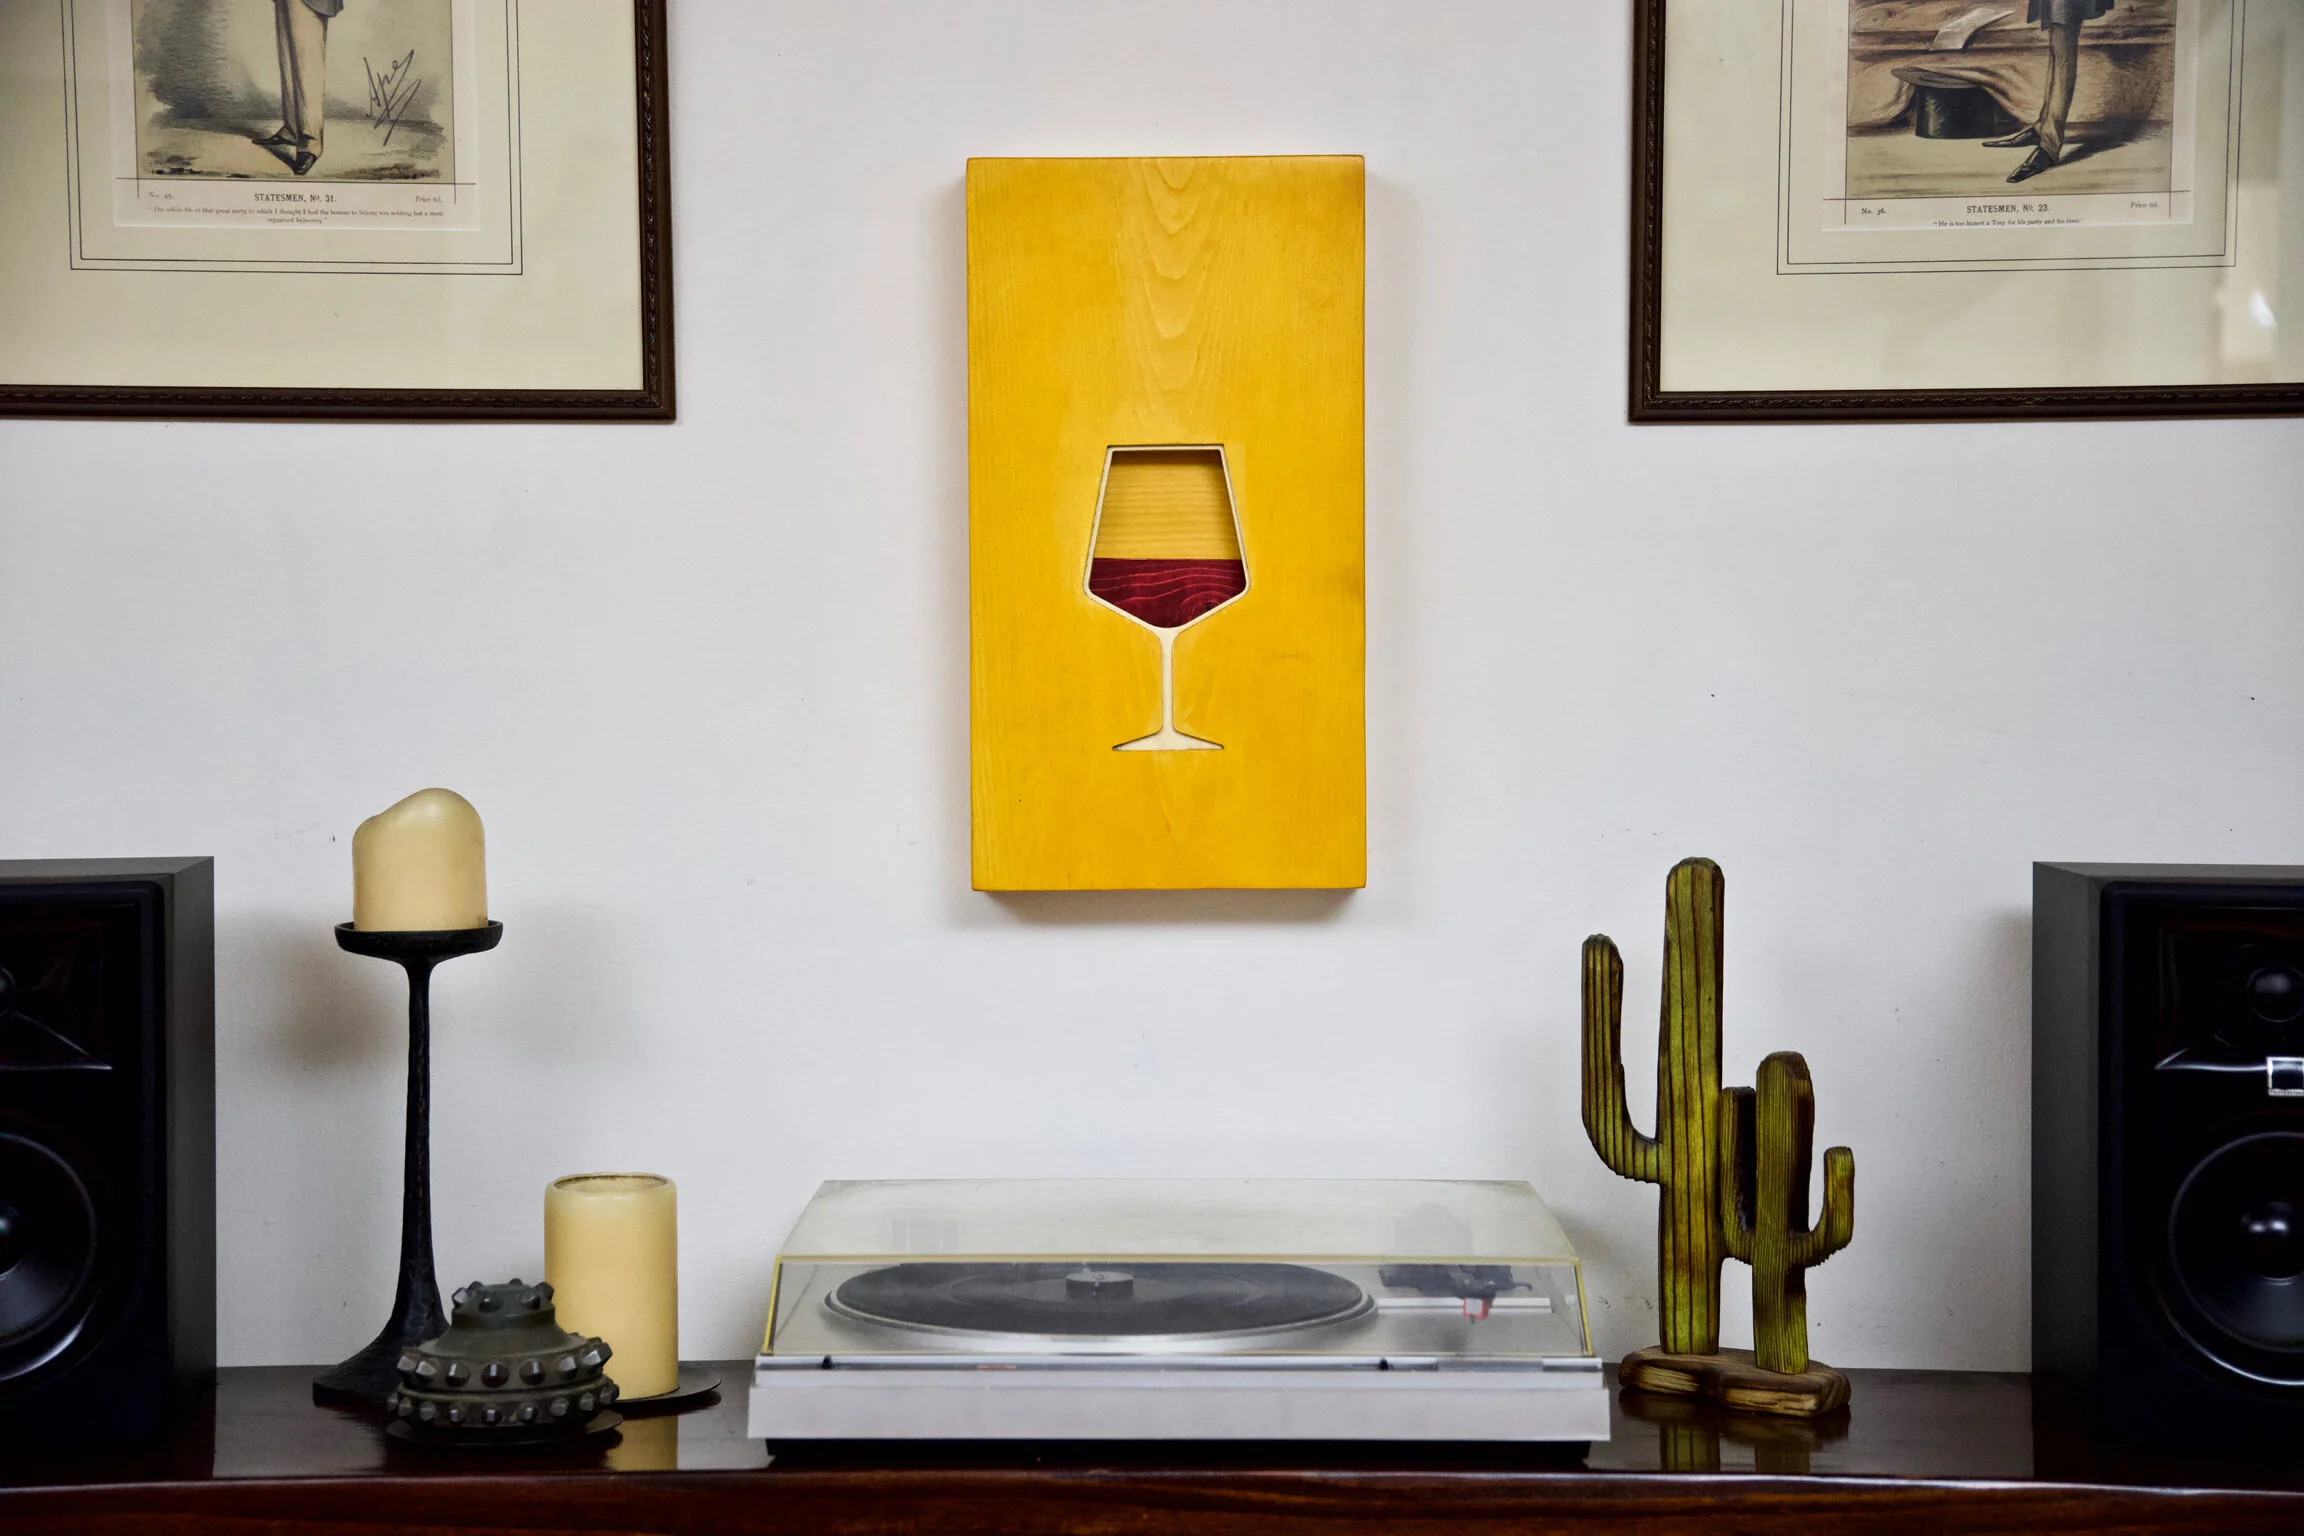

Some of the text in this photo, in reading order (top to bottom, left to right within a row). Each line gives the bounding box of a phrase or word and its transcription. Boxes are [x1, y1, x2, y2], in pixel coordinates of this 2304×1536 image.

[254, 193, 307, 203] STATESMEN,
[325, 194, 337, 203] 31.
[1966, 204, 2020, 214] STATESMEN,
[2130, 201, 2147, 209] Price
[202, 206, 214, 214] that
[215, 207, 231, 217] great
[279, 208, 302, 217] thought
[391, 209, 412, 217] nothing
[1861, 207, 1874, 215] No.
[1992, 219, 2006, 227] Tory
[2044, 217, 2055, 225] and
